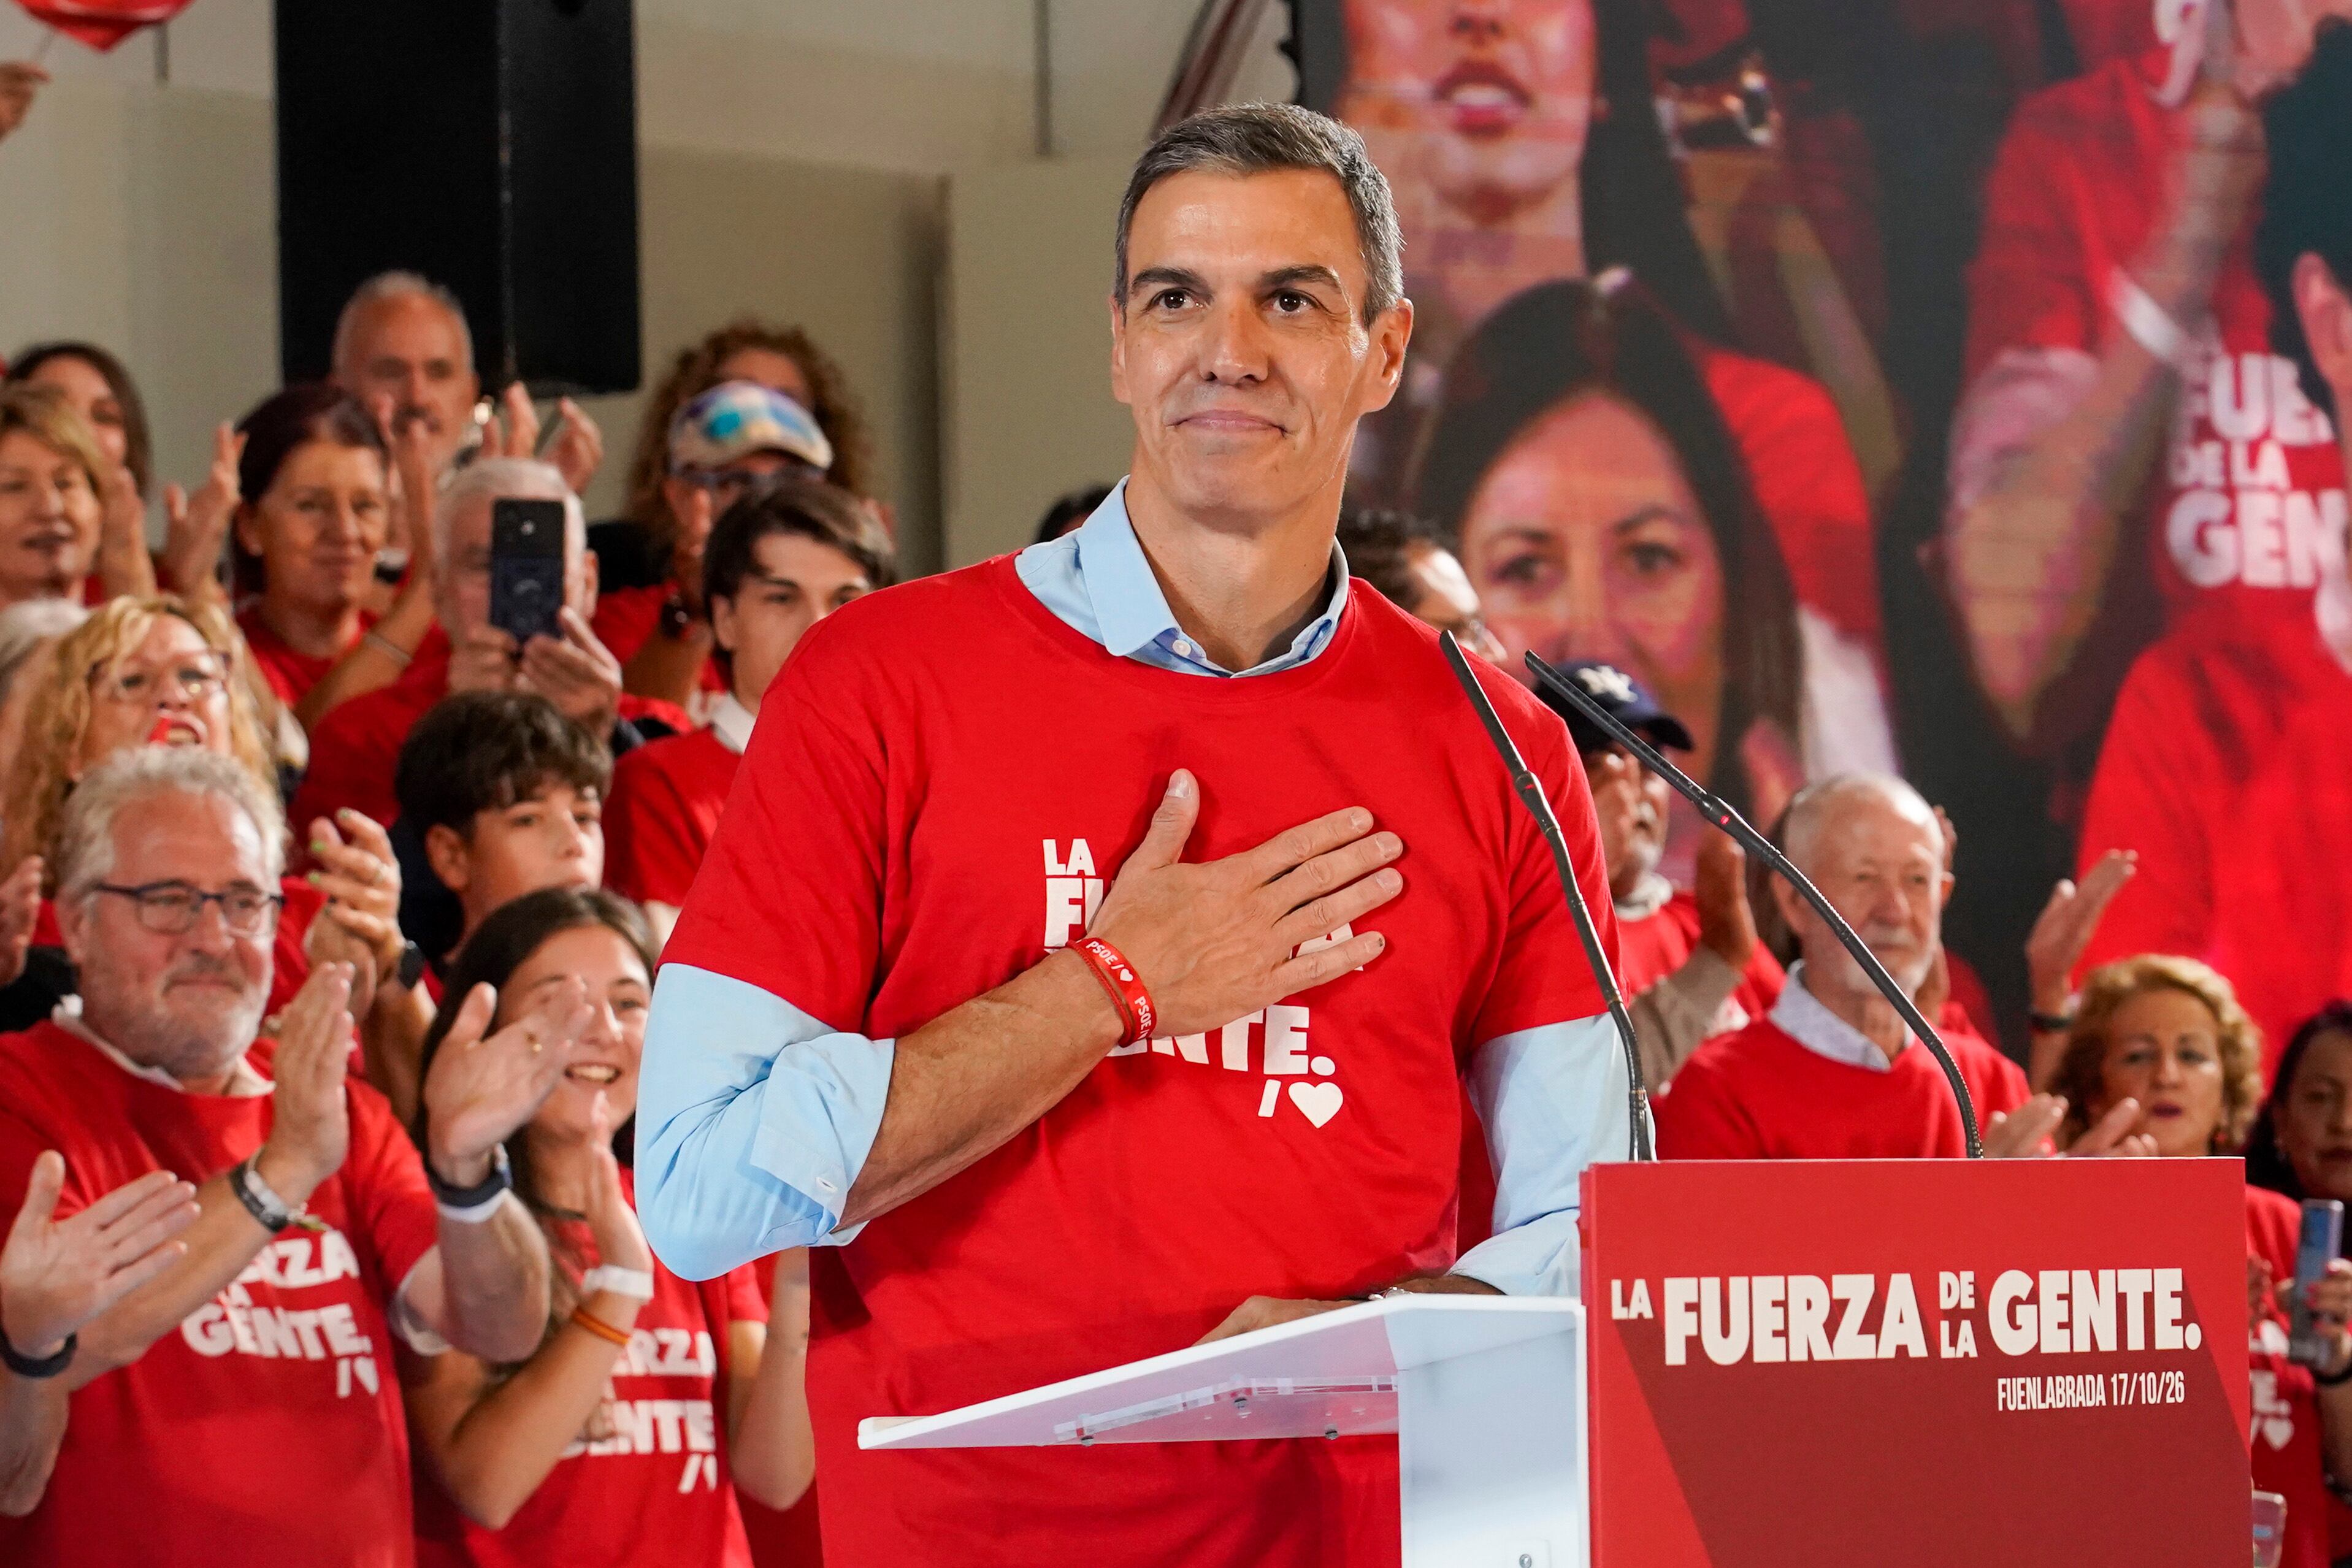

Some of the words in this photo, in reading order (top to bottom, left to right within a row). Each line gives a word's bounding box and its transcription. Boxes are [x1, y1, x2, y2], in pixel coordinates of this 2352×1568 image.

[2231, 438, 2290, 489] LA
[1043, 838, 1097, 876] LA
[1086, 941, 1118, 965] PSOE
[1135, 996, 1152, 1030] PSOE
[1611, 1279, 1653, 1320] LA
[1939, 1271, 1975, 1310] DE
[1664, 1273, 1928, 1366] FUERZA
[1988, 1268, 2202, 1356] GENTE.
[1940, 1320, 1979, 1358] LA
[1998, 1374, 2107, 1411] FUENLABRADA
[2110, 1371, 2185, 1406] 17/10/26
